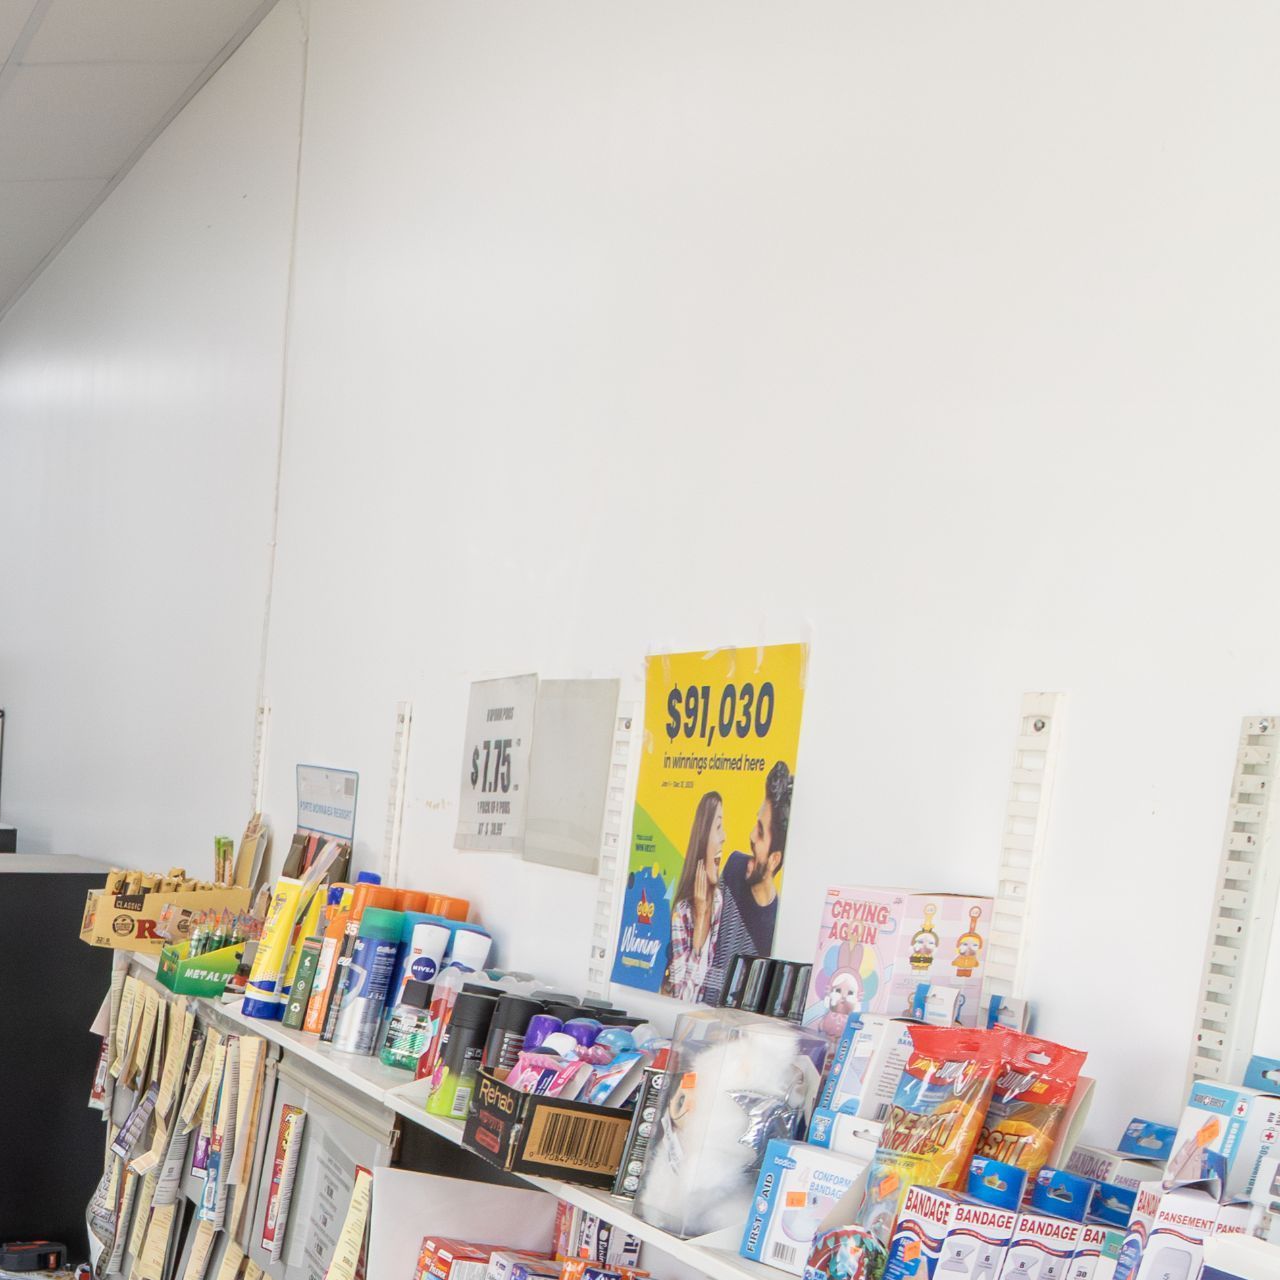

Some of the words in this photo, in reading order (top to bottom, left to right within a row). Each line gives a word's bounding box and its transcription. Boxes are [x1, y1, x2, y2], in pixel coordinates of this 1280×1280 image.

[665, 682, 775, 746] $91,030
[664, 752, 671, 769] in
[672, 753, 707, 775] winnings
[708, 752, 742, 771] claimed
[743, 754, 766, 772] here
[116, 900, 142, 911] CLASSIC
[831, 899, 890, 926] CRYING
[621, 922, 661, 968] Winning
[828, 921, 878, 946] AGAIN
[184, 968, 216, 982] METAL
[411, 963, 436, 975] NIVEA
[480, 1078, 514, 1115] Rehab
[745, 1216, 763, 1255] FIRST
[762, 1173, 775, 1200] AID
[905, 1188, 952, 1226] BANDAGE
[955, 1206, 1013, 1230] BANDAGE
[1018, 1217, 1078, 1242] BANDAGE
[1157, 1210, 1215, 1232] PANSEMENT
